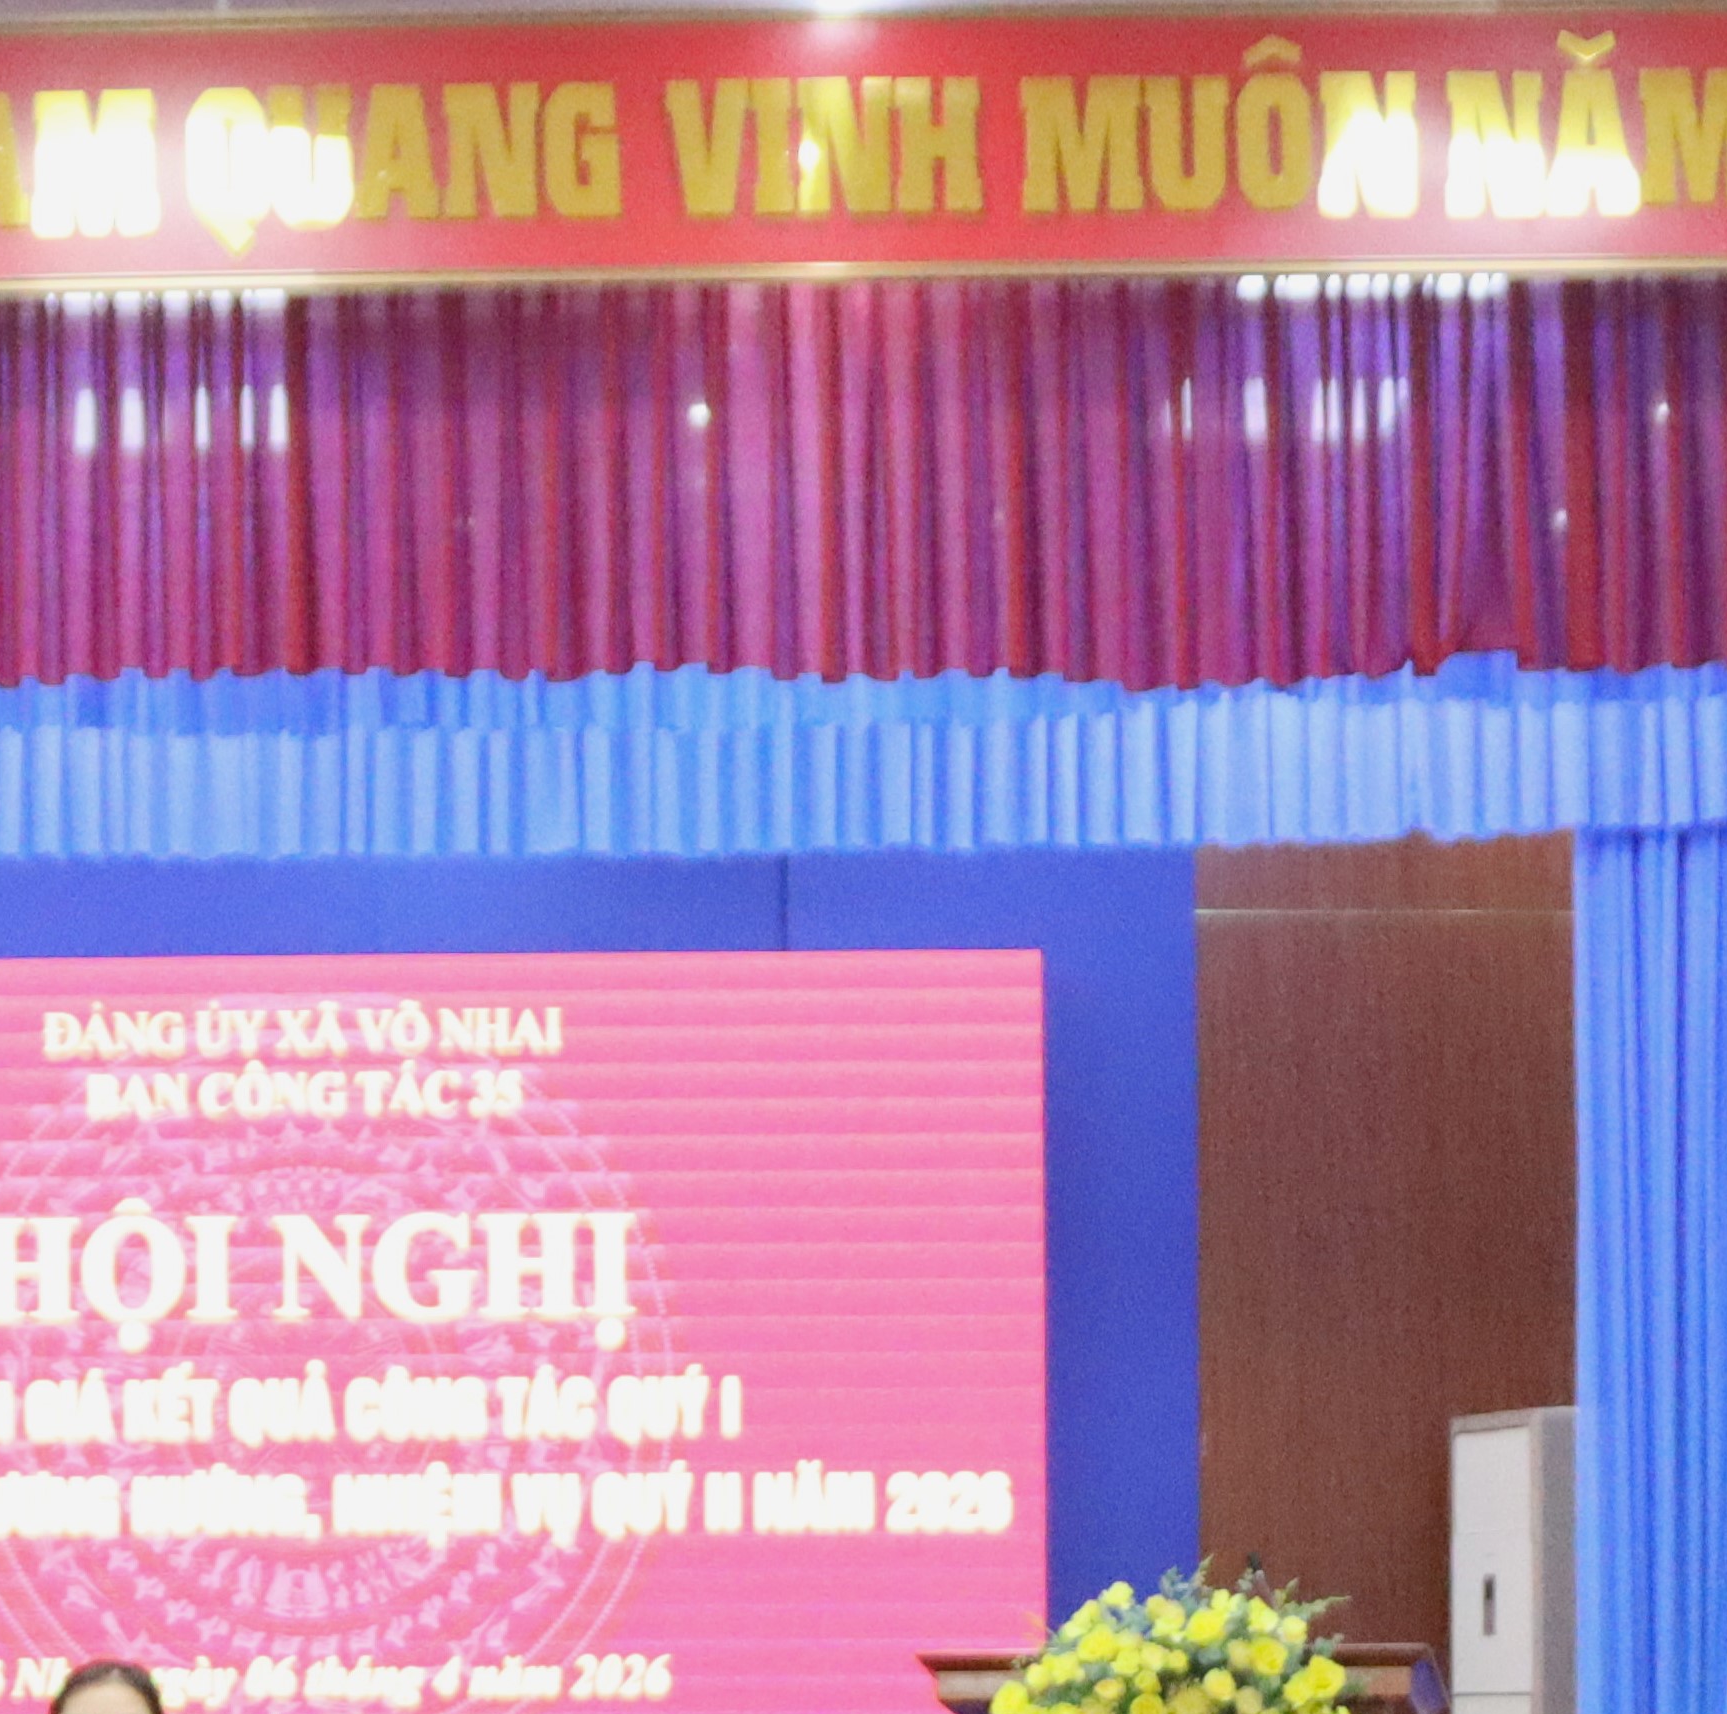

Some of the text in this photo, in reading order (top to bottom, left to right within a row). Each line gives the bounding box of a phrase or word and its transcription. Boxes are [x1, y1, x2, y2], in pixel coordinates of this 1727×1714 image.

[183, 80, 623, 256] QUANG
[663, 74, 985, 218] VINH
[1018, 34, 1421, 220] MUÔN
[43, 999, 562, 1057] ĐẢNG ỦY XÃ VÕ NHAI
[85, 1059, 523, 1120] BAN CÔNG TÁC 35
[270, 1211, 637, 1351] NGHỊ
[24, 1368, 115, 1445] GIÁ
[121, 1361, 219, 1443] KẾT
[229, 1359, 335, 1447] QUẢ
[345, 1365, 489, 1442] CÔNG
[495, 1364, 598, 1441] TÁC
[607, 1364, 709, 1445] QUÝ
[721, 1375, 741, 1438] I
[129, 1462, 322, 1542] HƯỚNG,
[332, 1461, 502, 1550] NHIỆM
[512, 1472, 583, 1549] VỤ
[592, 1460, 693, 1540] QUÝ
[705, 1472, 742, 1533] II
[754, 1459, 875, 1533] NĂM
[887, 1471, 1012, 1533] 2026
[243, 1655, 297, 1700] 06
[304, 1654, 427, 1708] tháng
[432, 1655, 462, 1697] 4
[469, 1655, 561, 1699] năm
[570, 1653, 672, 1698] 2026
